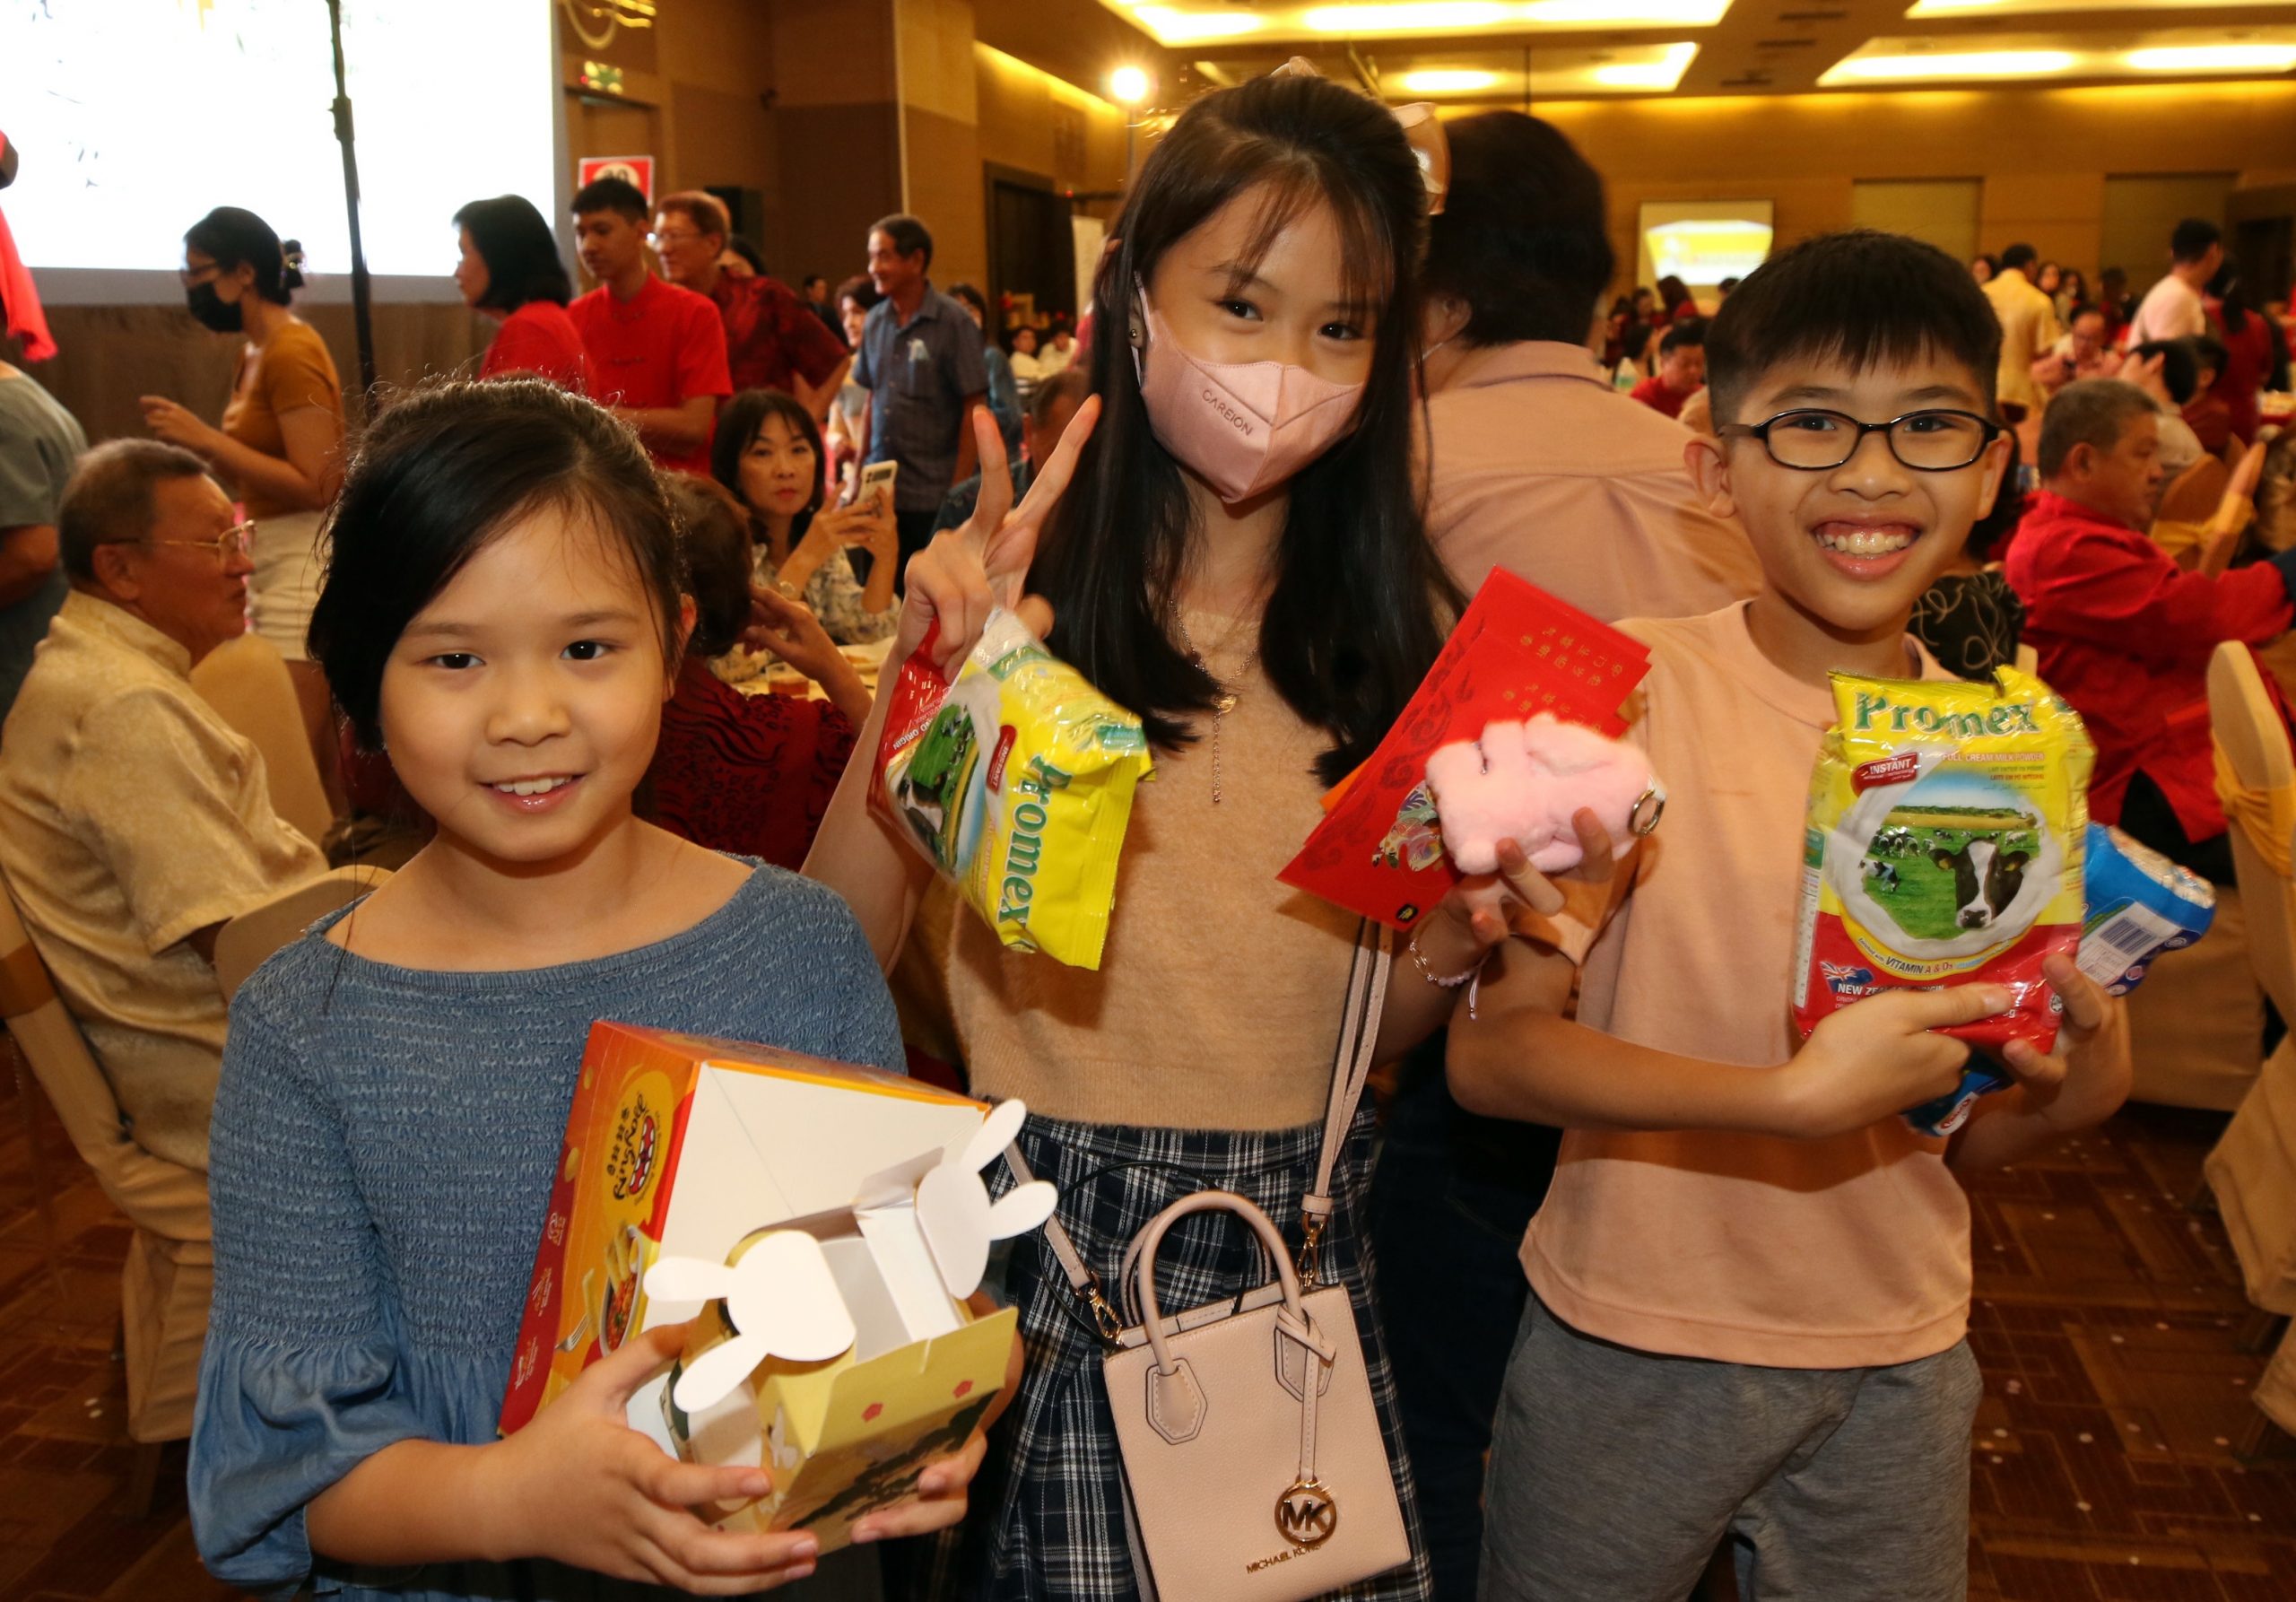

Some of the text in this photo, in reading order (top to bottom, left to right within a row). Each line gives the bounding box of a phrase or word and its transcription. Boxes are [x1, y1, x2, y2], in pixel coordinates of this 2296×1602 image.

[1202, 389, 1253, 436] CAREION
[1852, 692, 2041, 741] Promex
[892, 728, 919, 750] ORIGIN
[992, 745, 1008, 790] INSTANT
[1869, 758, 1912, 775] INSTANT
[1965, 753, 1994, 762] CREAM
[1995, 753, 2014, 762] MILK
[2015, 752, 2045, 762] POWDER
[996, 754, 1074, 929] Promex
[1885, 956, 1924, 974] VITAMIN
[1925, 966, 1932, 974] A
[1837, 983, 1864, 996] NEW
[1283, 1498, 1331, 1533] MK
[1245, 1551, 1292, 1575] MICHAEL
